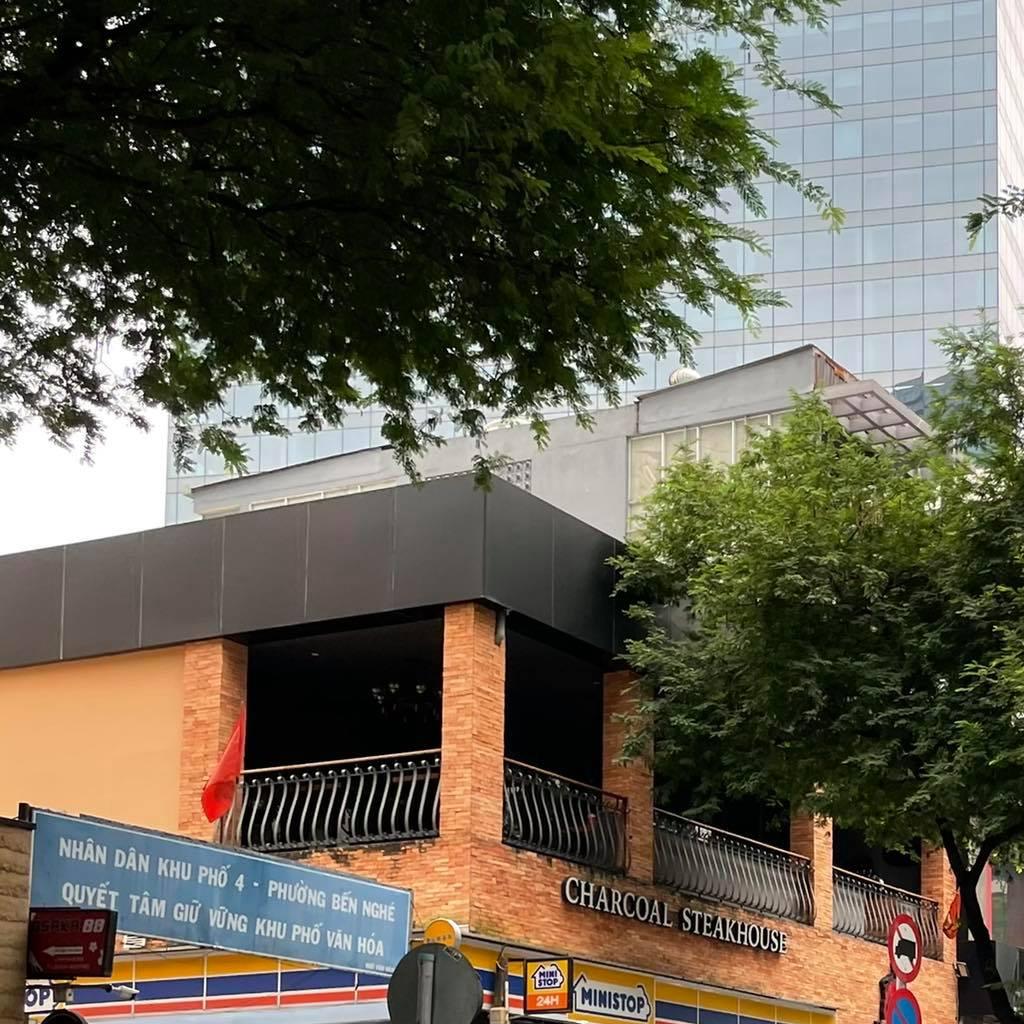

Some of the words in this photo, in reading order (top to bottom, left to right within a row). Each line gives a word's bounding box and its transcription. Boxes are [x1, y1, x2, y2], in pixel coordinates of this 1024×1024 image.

[59, 837, 107, 865] NHÂN
[114, 847, 150, 873] DÂN
[157, 857, 192, 881] KHU
[198, 864, 232, 888] PHỐ
[235, 874, 244, 892] 4
[268, 880, 326, 908] PHƯỜNG
[331, 891, 358, 914] BẾN
[362, 901, 395, 922] NGHÉ
[62, 881, 119, 913] QUYẾT
[129, 891, 165, 918] TÂM
[173, 900, 202, 924] GIỮ
[209, 906, 248, 933] VỮNG
[255, 917, 287, 940] KHU
[291, 922, 324, 945] PHỐ
[327, 929, 351, 951] VĂN
[358, 933, 384, 957] HÓA
[82, 918, 105, 933] 88
[565, 876, 673, 928] CHARCOAL
[682, 907, 789, 954] STEAKHOUSE
[538, 979, 558, 987] STOP
[539, 969, 558, 979] MINI
[536, 995, 560, 1007] 24H
[581, 986, 645, 1014] MINISTOP
